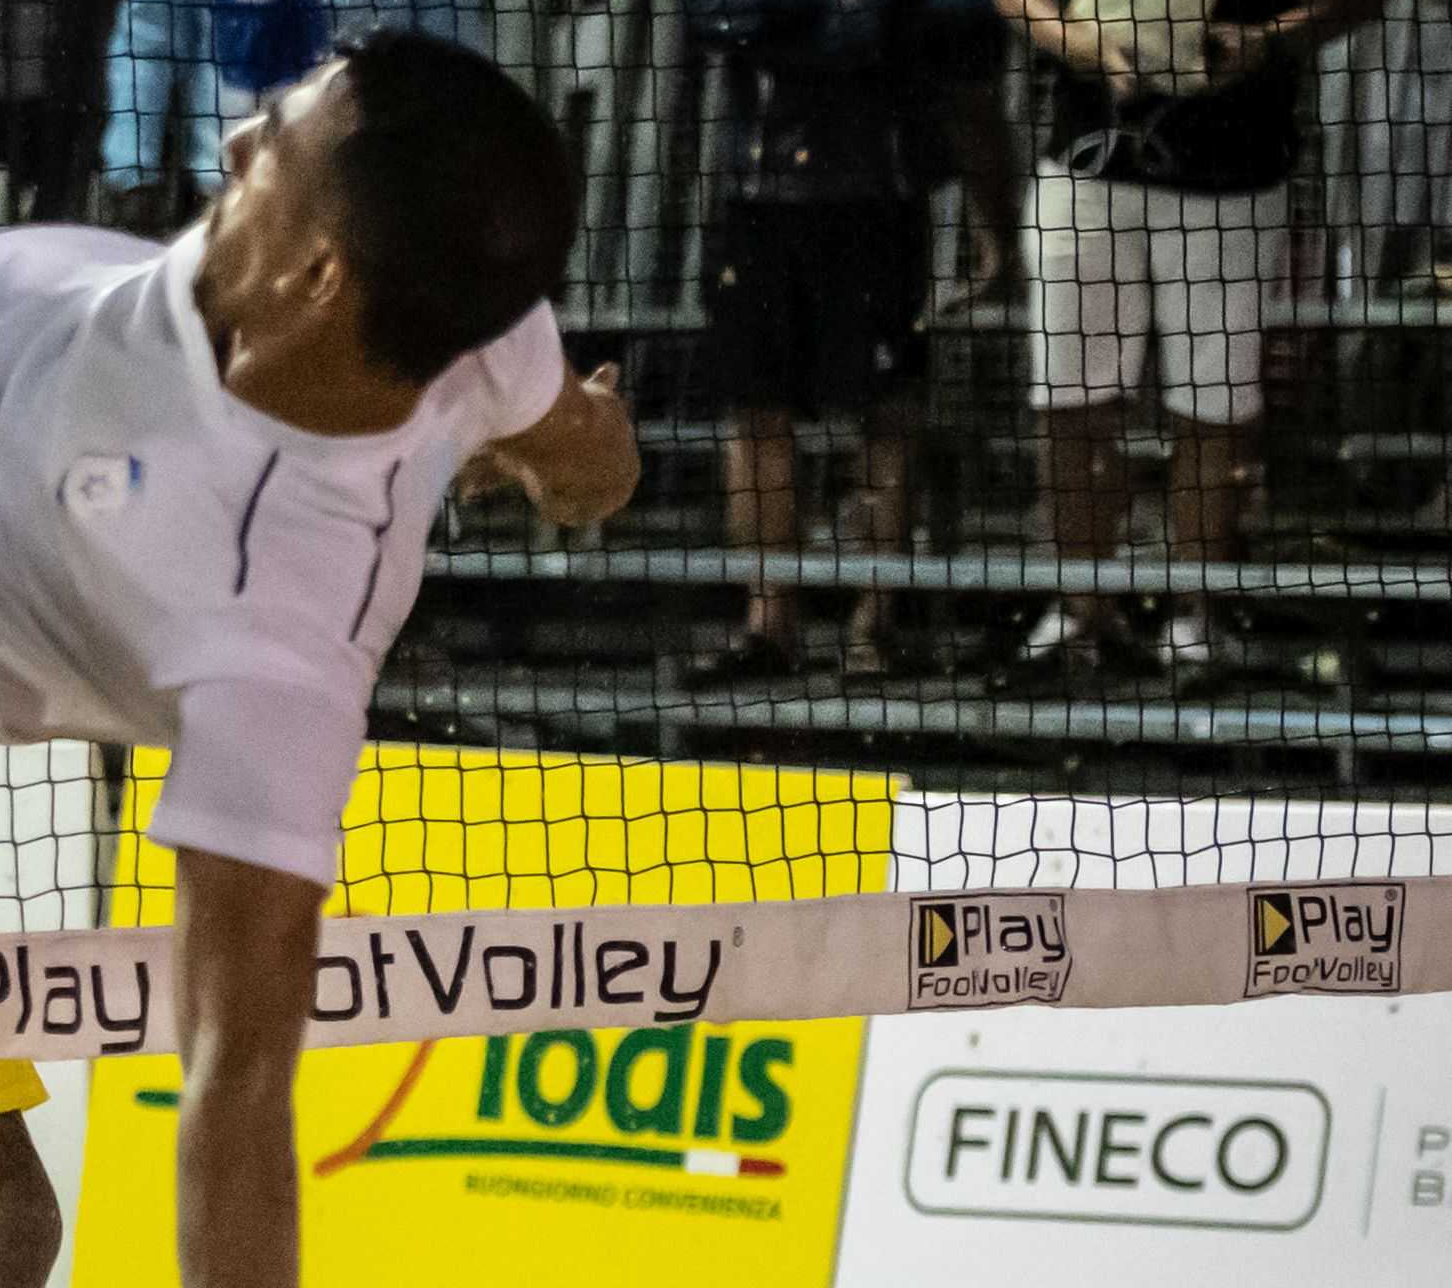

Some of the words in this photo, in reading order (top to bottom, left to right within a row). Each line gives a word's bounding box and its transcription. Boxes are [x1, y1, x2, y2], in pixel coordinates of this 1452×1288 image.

[961, 904, 1066, 963] Play
[1298, 895, 1394, 954] Play
[942, 1104, 1291, 1197] FINECO
